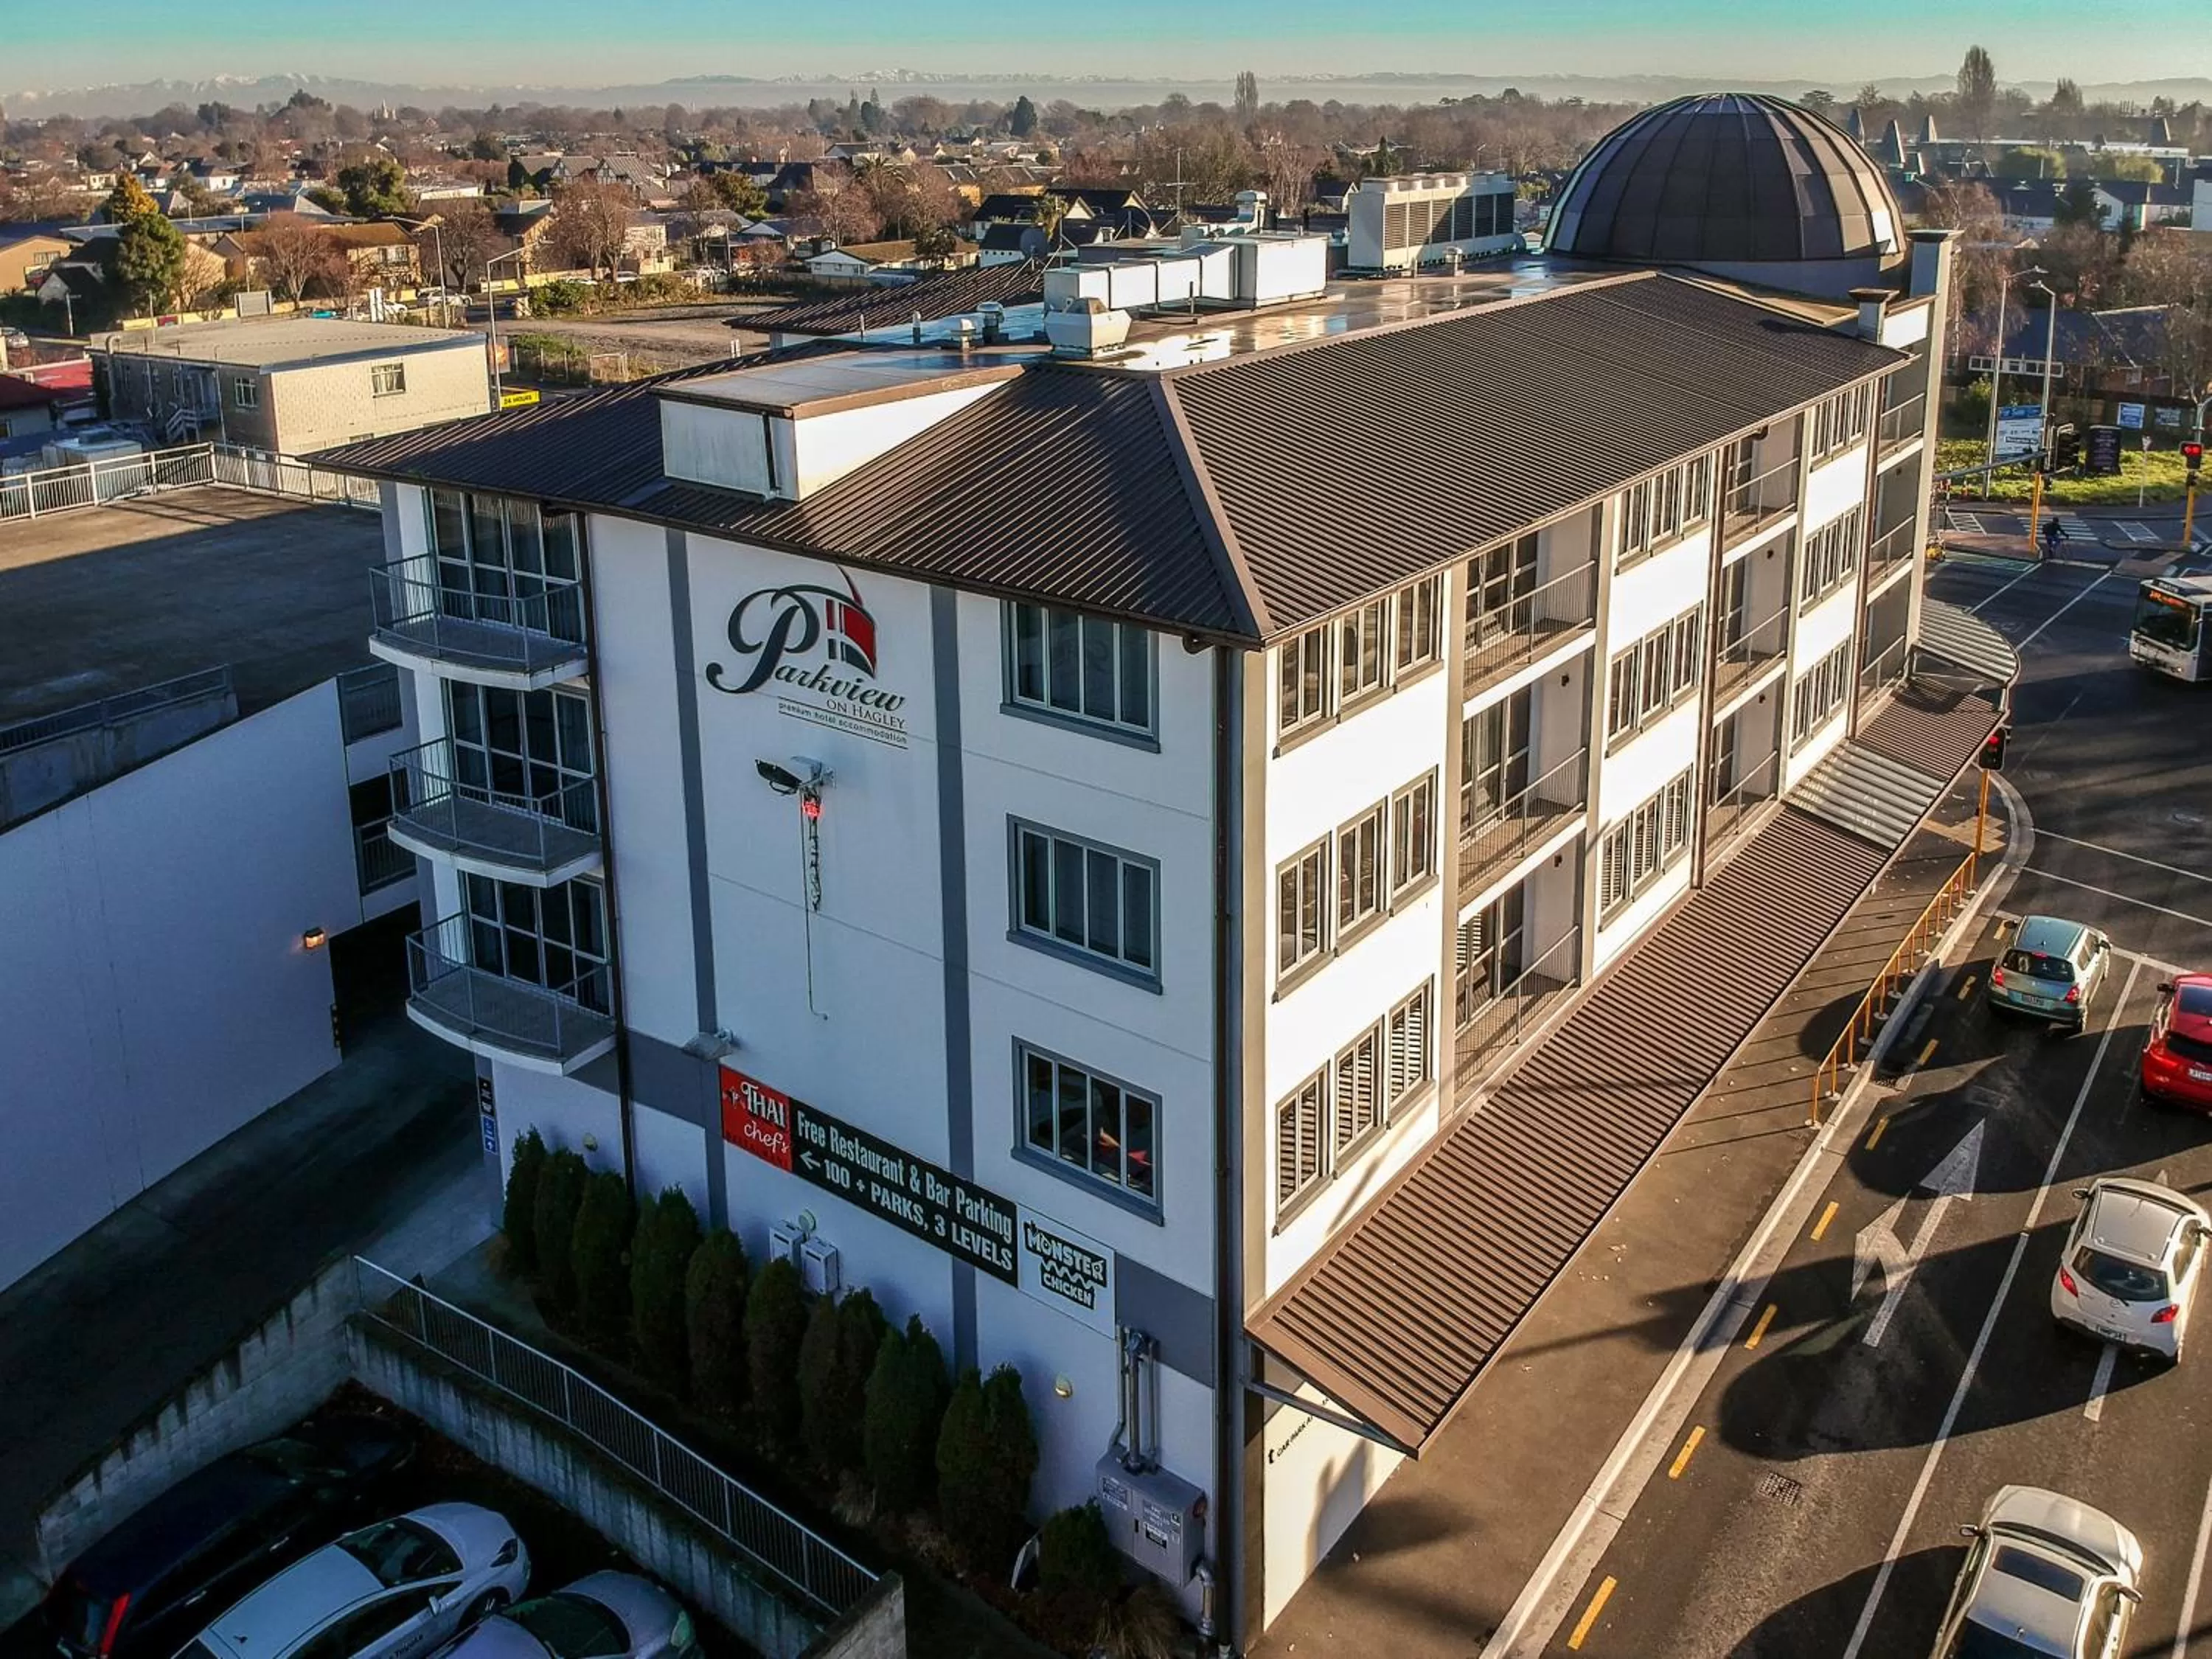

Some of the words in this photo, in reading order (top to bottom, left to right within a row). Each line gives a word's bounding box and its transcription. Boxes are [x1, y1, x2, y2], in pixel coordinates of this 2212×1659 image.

[706, 585, 905, 712] Parkview
[778, 703, 812, 717] premium
[814, 711, 836, 724] hotel
[839, 719, 908, 744] accommodation
[827, 698, 848, 714] ON
[852, 704, 905, 729] HAGLEY
[797, 1110, 826, 1148] Free
[830, 1125, 905, 1186] Restaurant
[909, 1165, 921, 1195] &
[925, 1171, 950, 1209] Bar
[956, 1186, 1012, 1245] Parking
[824, 1158, 850, 1189] 100
[856, 1180, 866, 1192] +
[871, 1180, 929, 1231] PARKS,
[934, 1214, 946, 1237] 3
[951, 1222, 1013, 1271] LEVELS
[1027, 1227, 1105, 1281] MONSTER
[1043, 1273, 1092, 1306] CHICKEN
